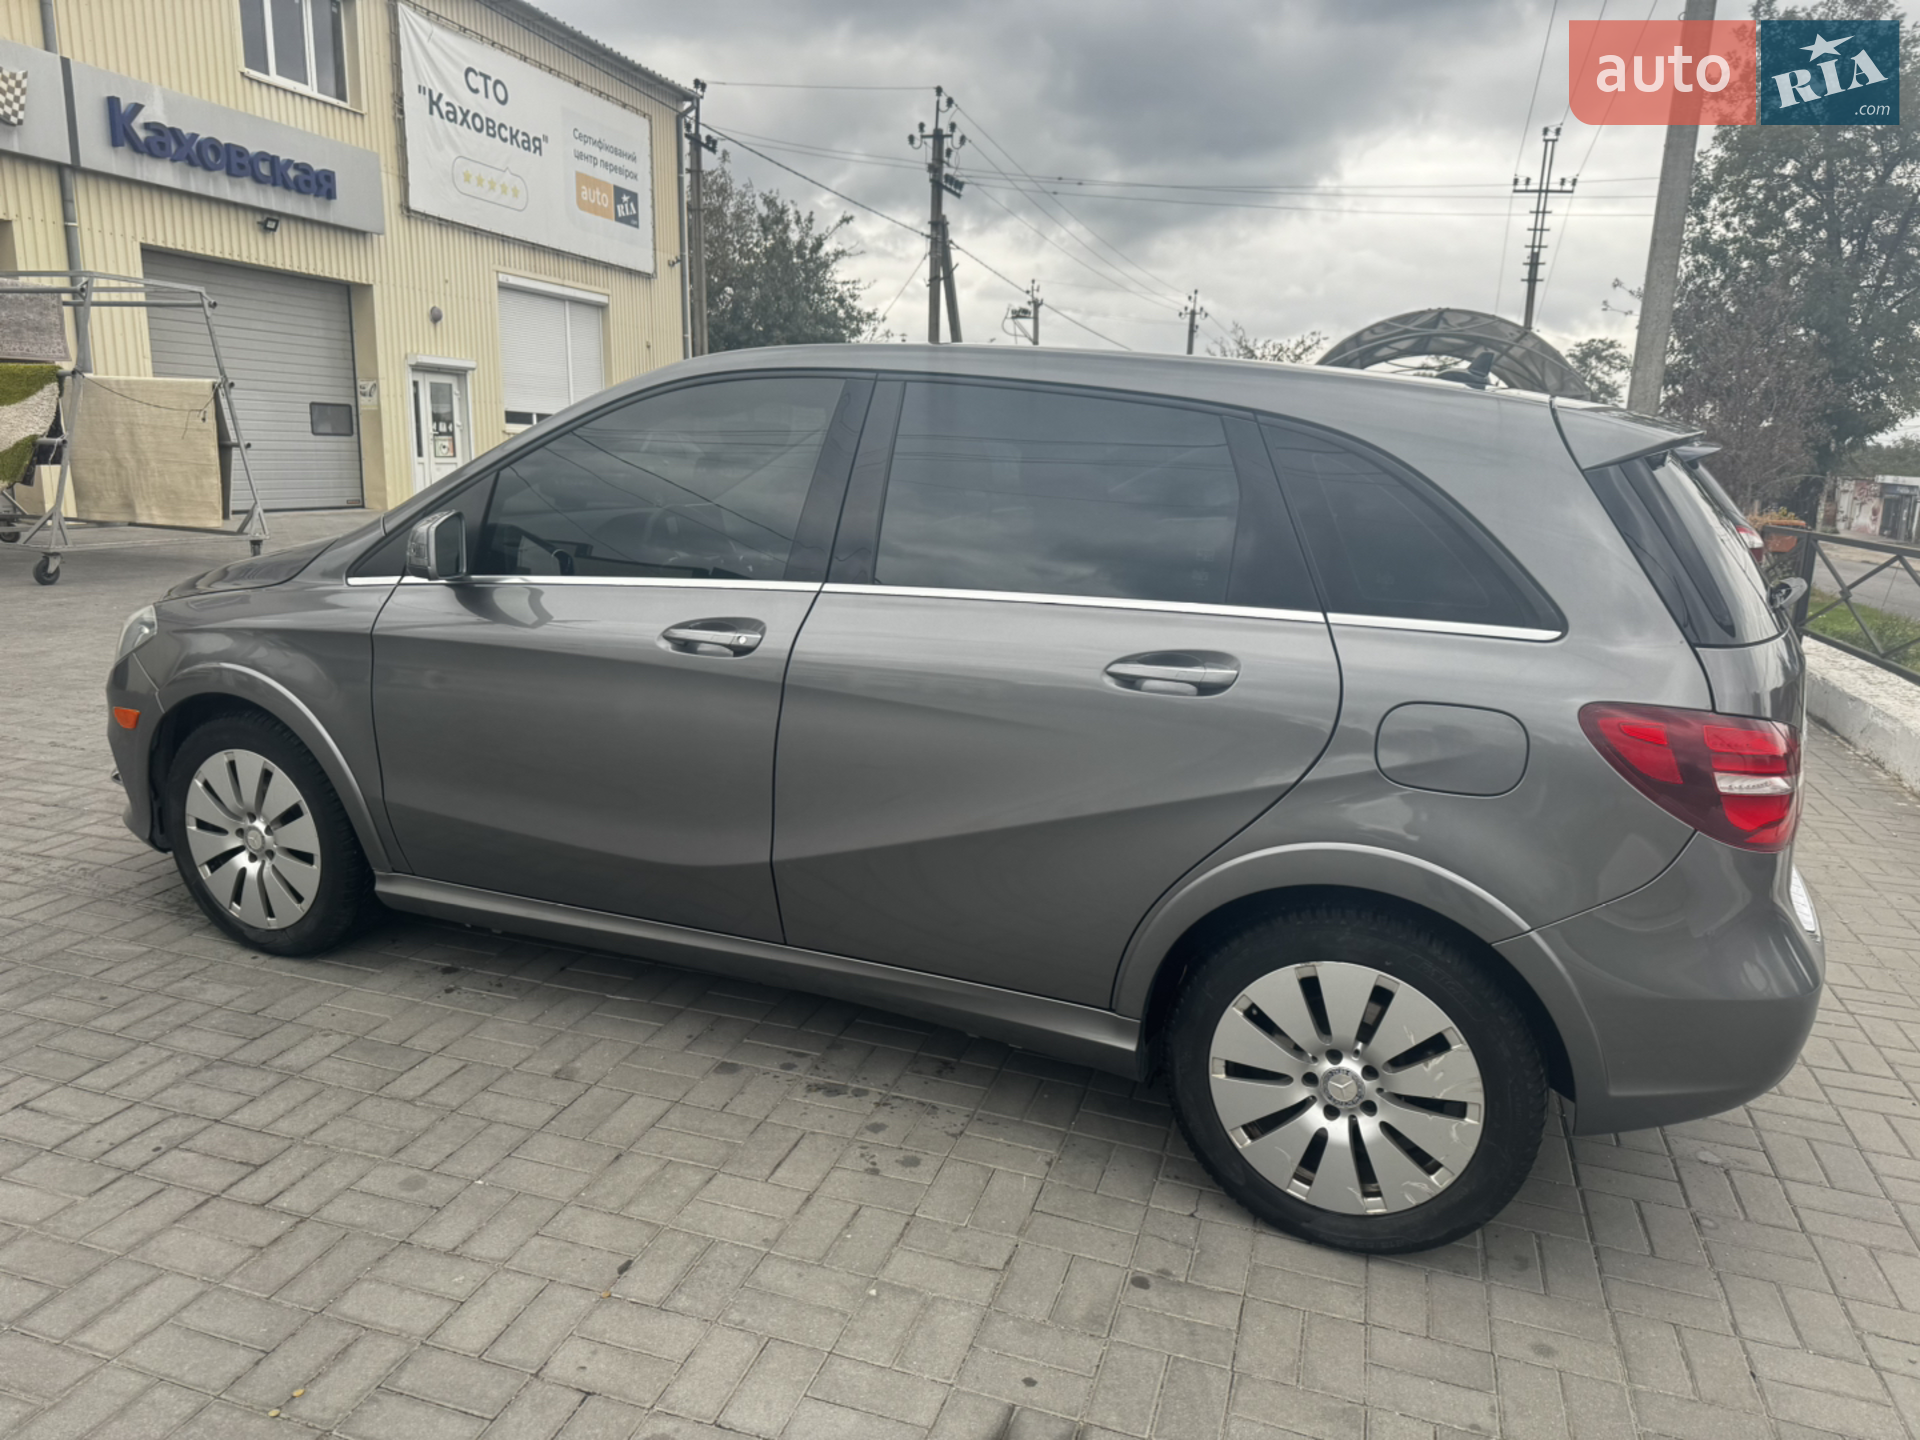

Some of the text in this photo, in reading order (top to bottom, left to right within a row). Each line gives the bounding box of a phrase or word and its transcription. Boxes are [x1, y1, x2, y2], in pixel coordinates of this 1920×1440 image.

[464, 66, 509, 106] СТО
[418, 84, 549, 157] "Каховская"
[106, 95, 337, 200] Каховская
[572, 127, 637, 164] Сертифікований
[573, 148, 638, 181] центр перевірок
[581, 185, 637, 217] auto RIA
